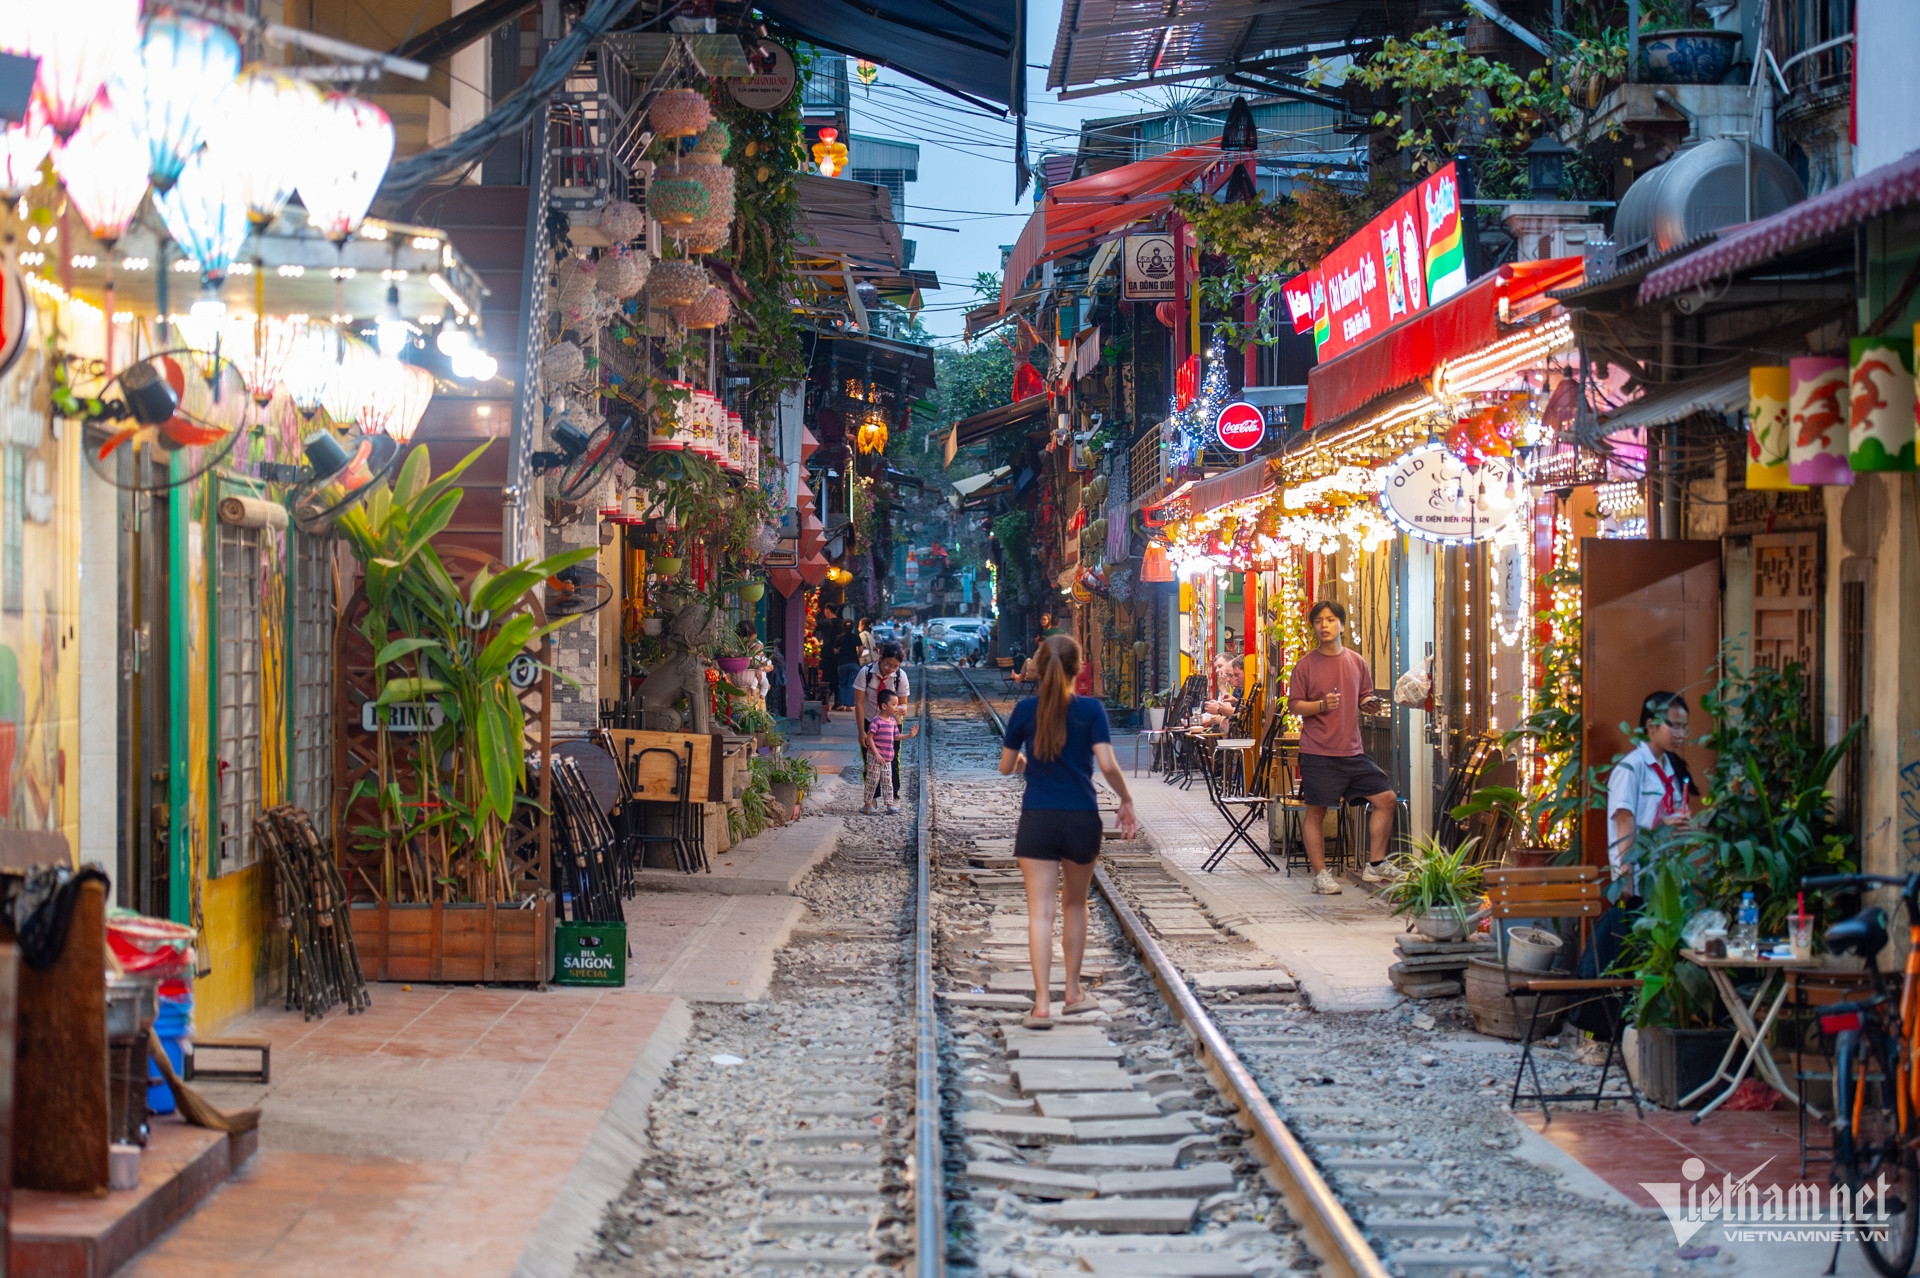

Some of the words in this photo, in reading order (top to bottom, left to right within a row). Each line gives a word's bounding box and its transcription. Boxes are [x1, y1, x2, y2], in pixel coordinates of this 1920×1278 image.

[1128, 281, 1137, 290] GA
[1328, 275, 1342, 314] Old
[1393, 459, 1425, 488] OLD
[563, 957, 613, 969] SAIGON
